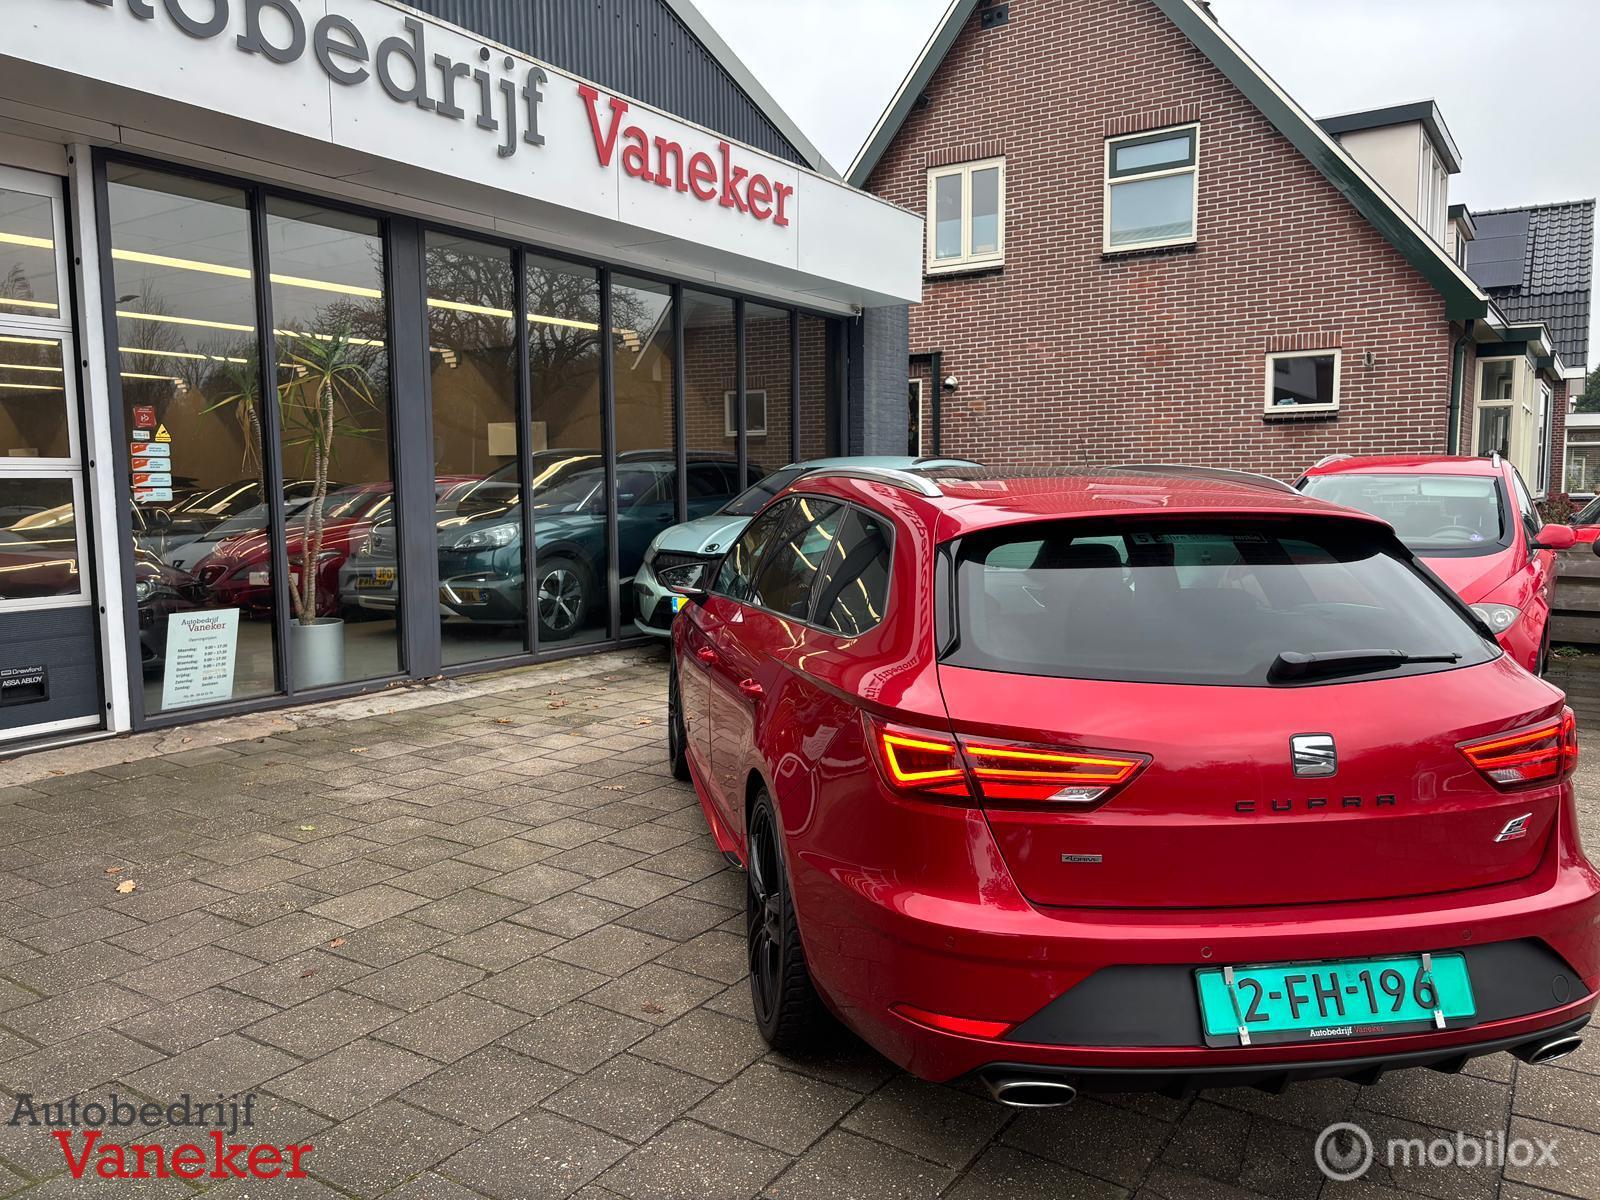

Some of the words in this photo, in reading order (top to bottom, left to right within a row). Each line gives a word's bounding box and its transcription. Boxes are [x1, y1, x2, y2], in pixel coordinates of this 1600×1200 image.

[578, 84, 794, 227] Vaneker
[181, 616, 219, 626] Autobedrijf
[188, 622, 227, 632] Vaneker
[2, 679, 20, 687] ASSA
[21, 676, 43, 685] ABLOY
[1235, 794, 1396, 813] CUPRA
[1237, 966, 1438, 1023] 2-FH-196
[1309, 1026, 1353, 1038] Autobedrijf
